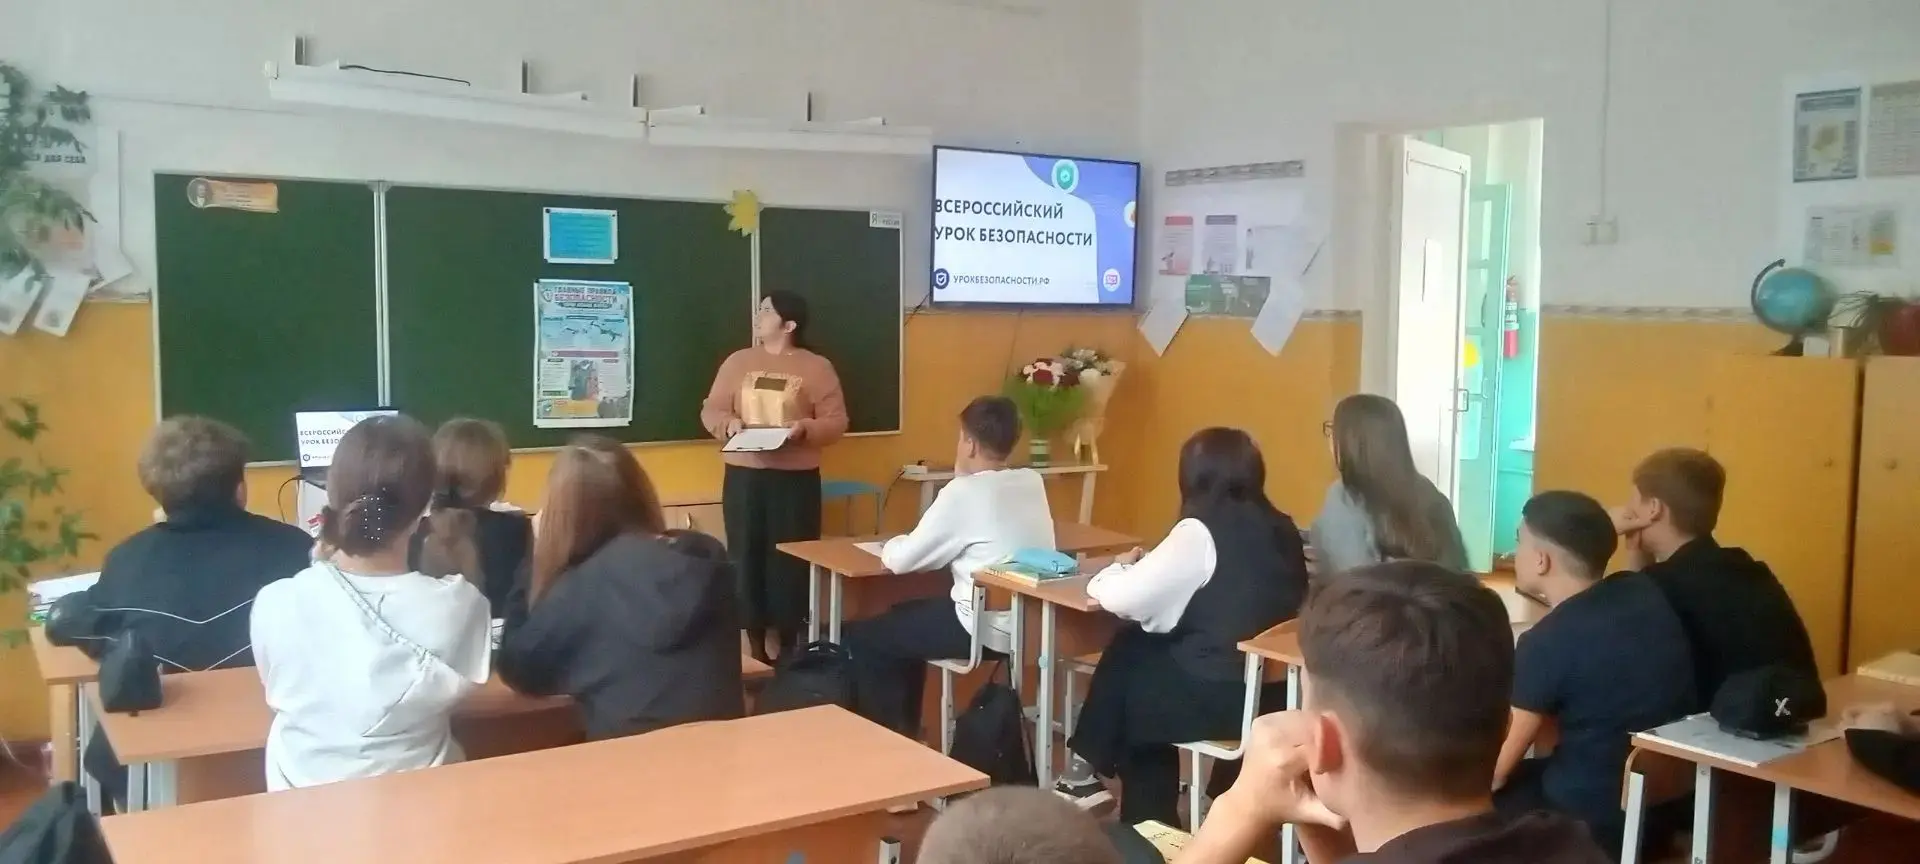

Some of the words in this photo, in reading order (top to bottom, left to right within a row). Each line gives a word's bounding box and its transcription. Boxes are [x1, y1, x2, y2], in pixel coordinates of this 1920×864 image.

[935, 199, 1064, 219] ВСЕРОССИЙСКИЙ
[935, 226, 976, 242] УРОК
[979, 228, 1093, 247] БЕЗОПАСНОСТИ
[953, 274, 1051, 287] УРОКБЕЗОПАСНОСТИ.РФ
